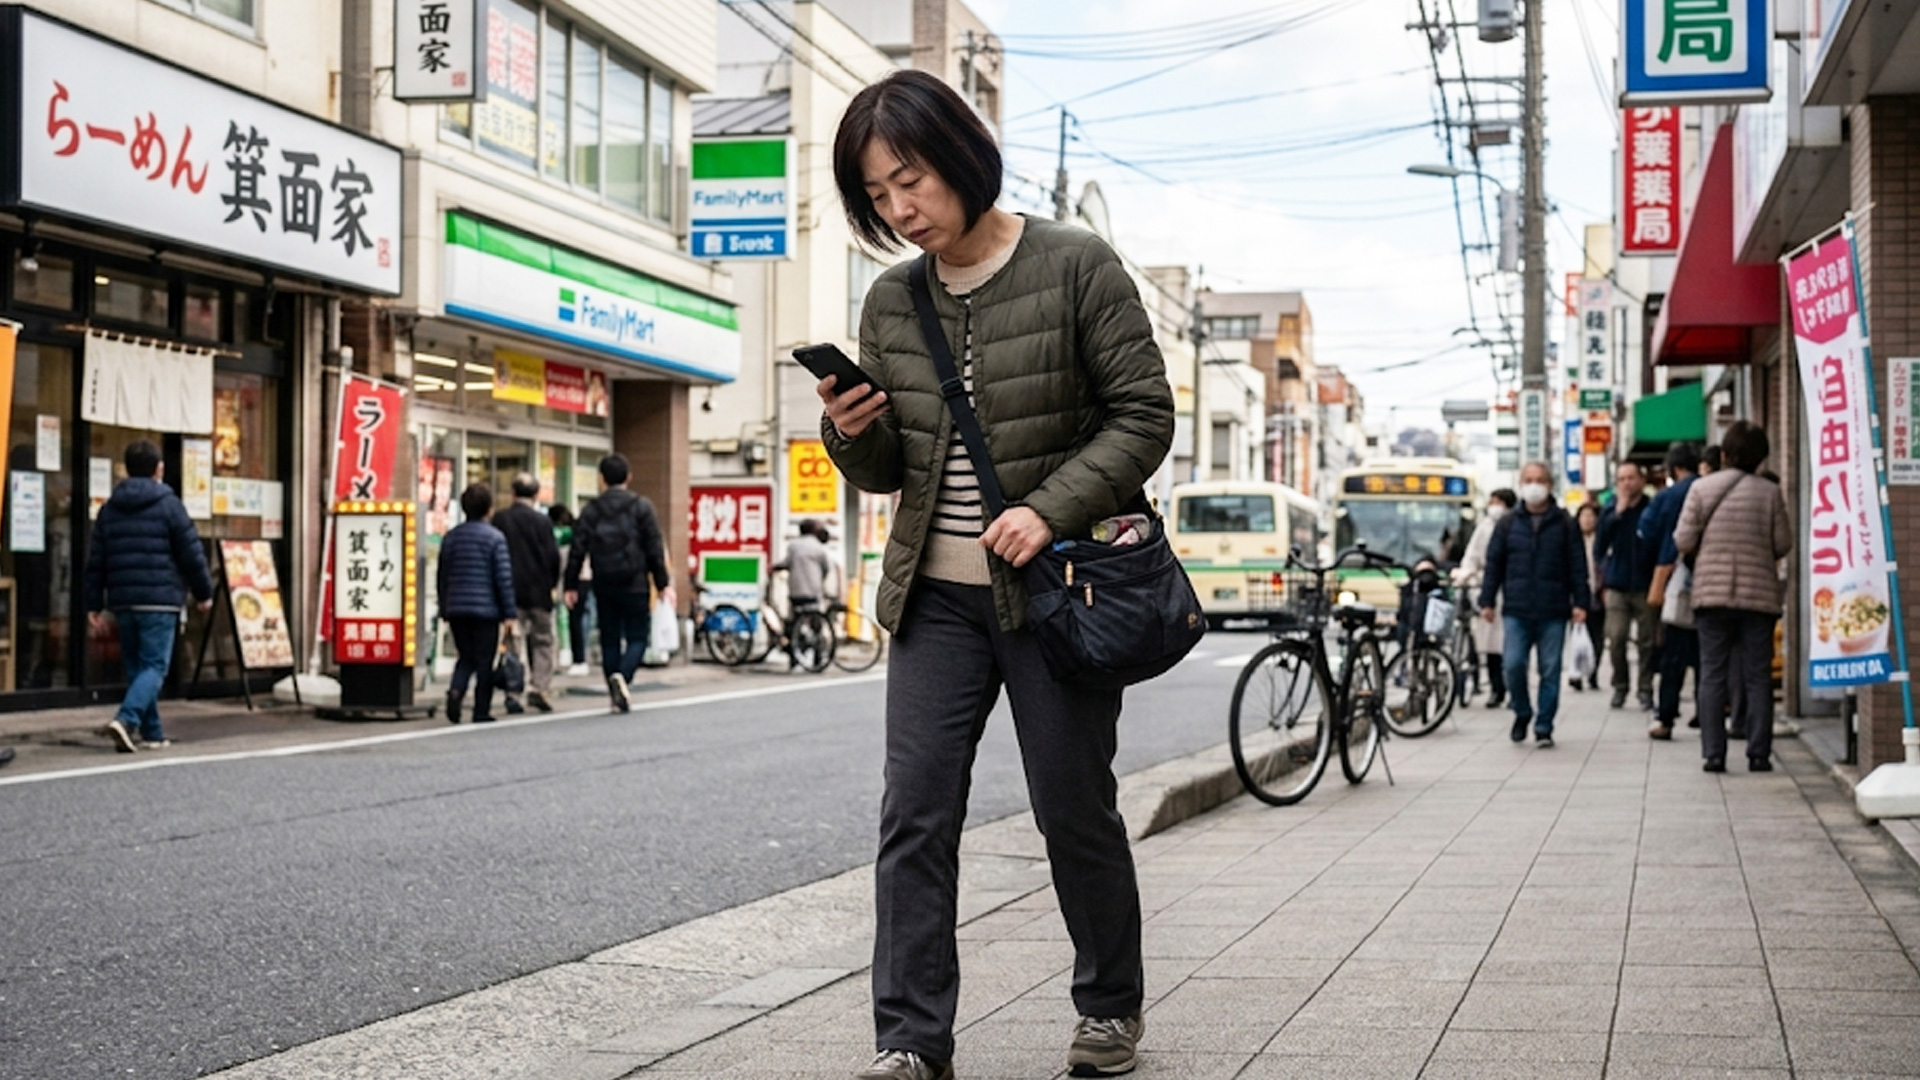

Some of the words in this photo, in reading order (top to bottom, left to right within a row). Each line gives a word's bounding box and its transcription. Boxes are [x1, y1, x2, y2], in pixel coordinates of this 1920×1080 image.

[416, 0, 451, 74] 面家
[46, 79, 209, 194] らーめん
[220, 119, 374, 257] 箕面家
[693, 189, 785, 209] FamilyMart
[581, 295, 655, 344] FamilyMart
[378, 522, 395, 592] らーめん
